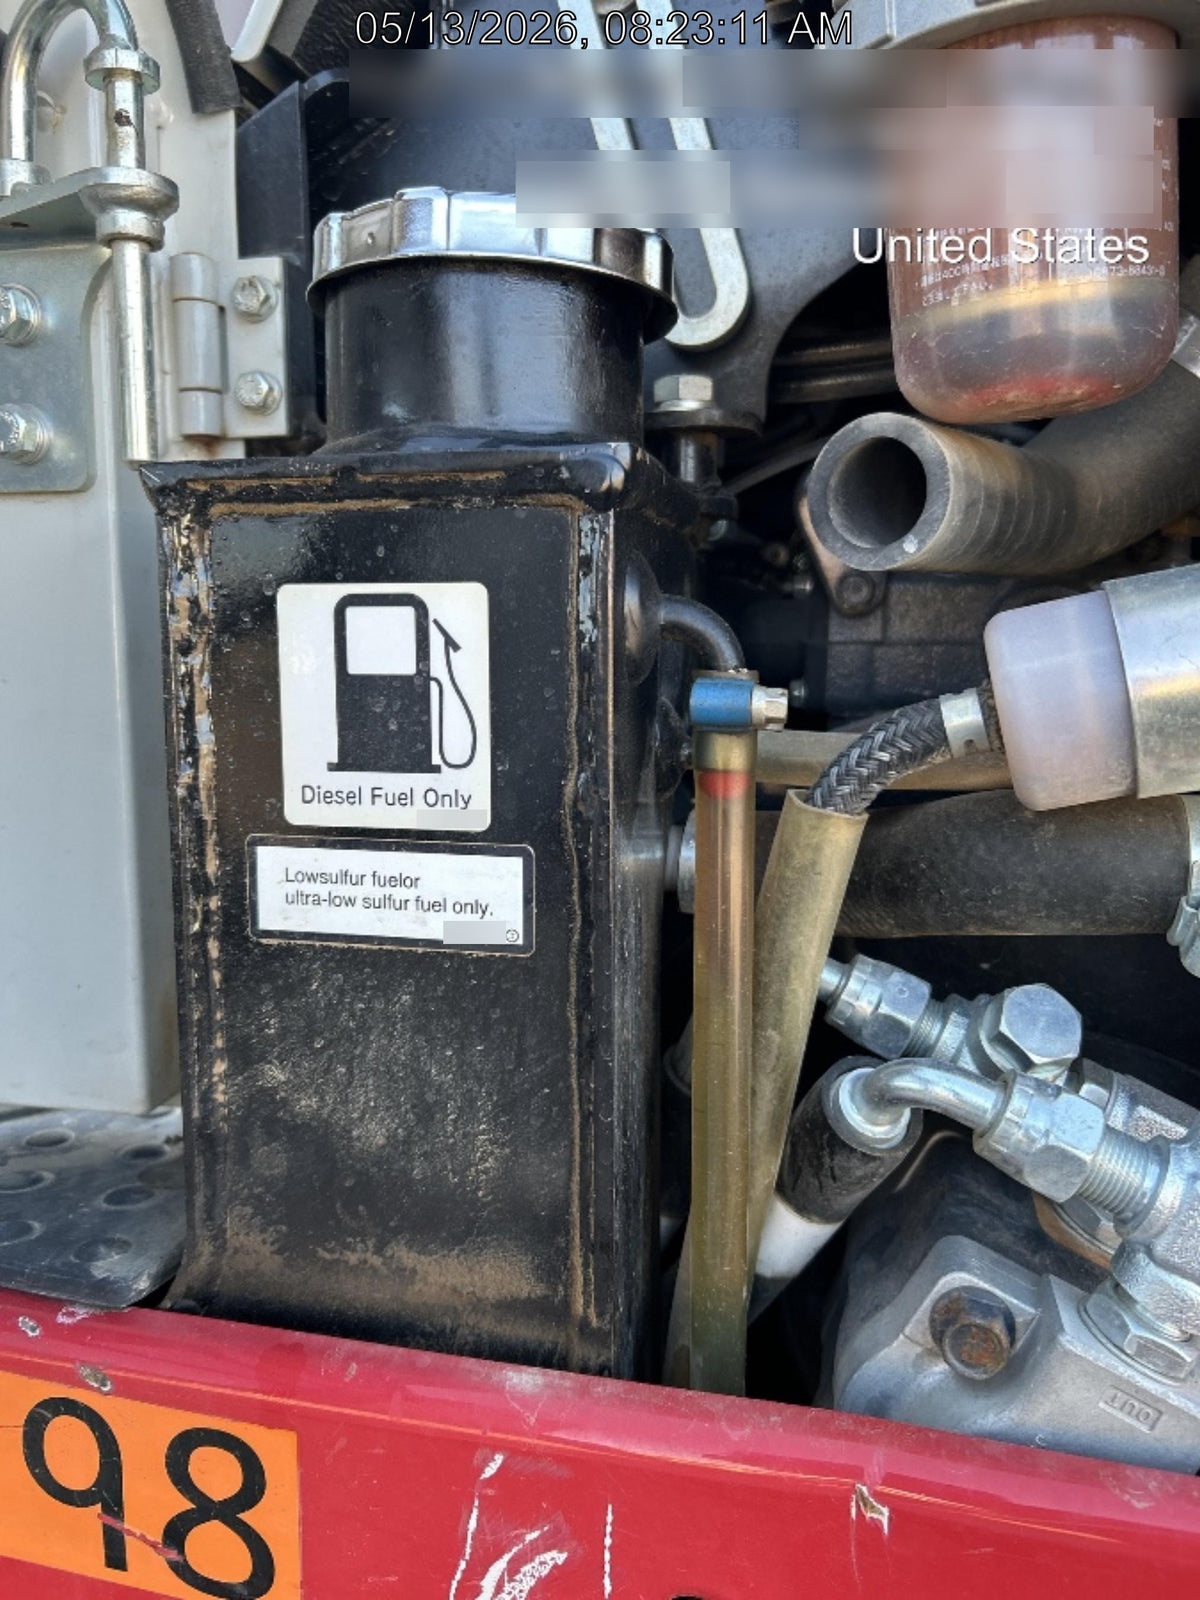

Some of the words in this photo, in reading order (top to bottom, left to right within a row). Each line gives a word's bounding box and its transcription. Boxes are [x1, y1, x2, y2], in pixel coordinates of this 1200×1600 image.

[301, 784, 362, 805] Diesel
[370, 786, 413, 806] Fuel
[423, 787, 472, 810] Only
[285, 890, 356, 908] ultra-low
[362, 893, 409, 911] sulfur
[415, 895, 447, 913] fuel
[452, 899, 494, 919] only.
[1104, 1391, 1153, 1422] OUT
[22, 1396, 275, 1600] 98
